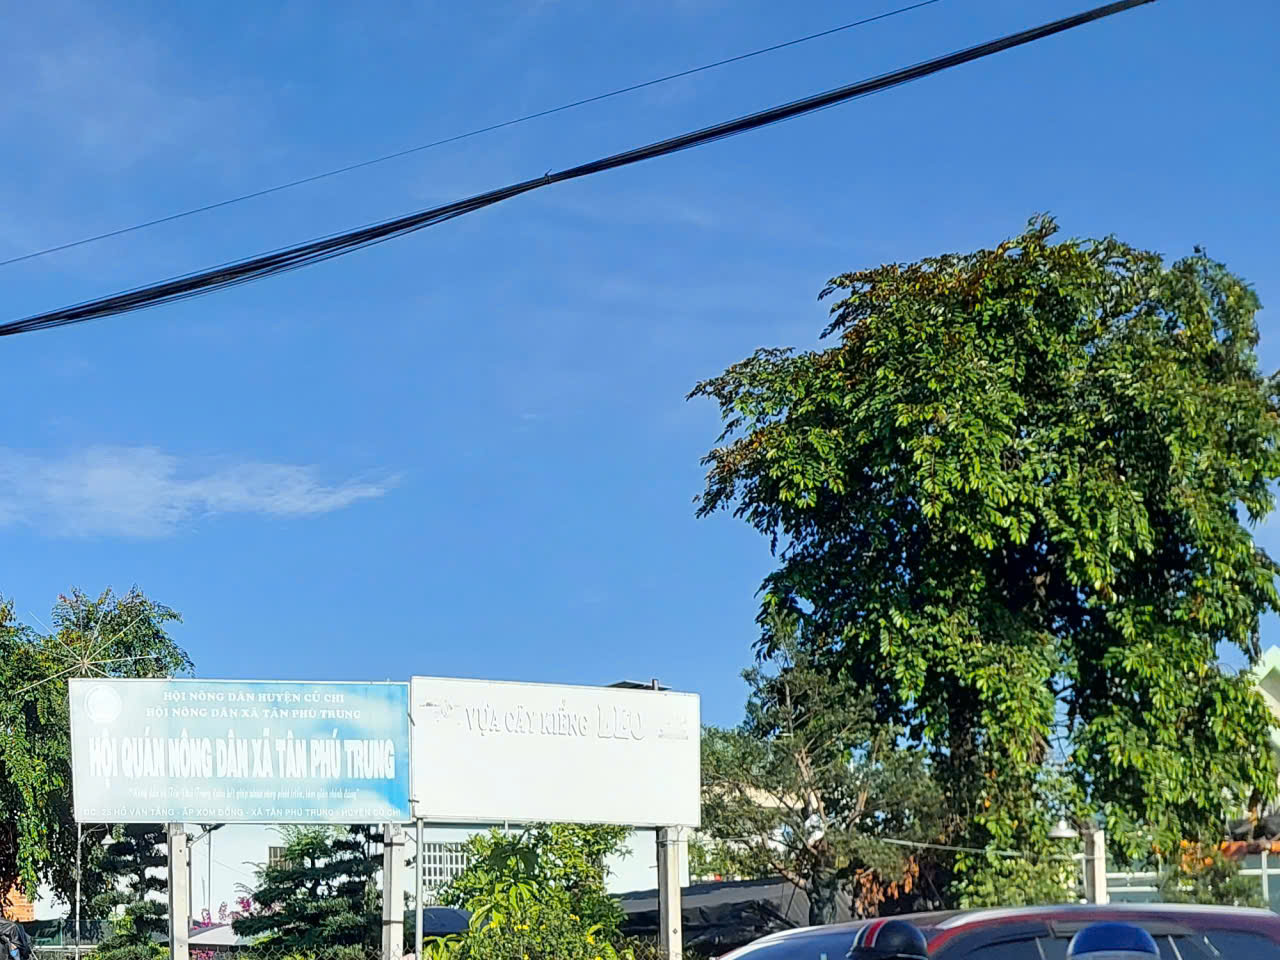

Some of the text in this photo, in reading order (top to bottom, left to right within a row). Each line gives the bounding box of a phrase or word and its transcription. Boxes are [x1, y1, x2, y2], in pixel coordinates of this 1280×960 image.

[163, 689, 186, 703] HỘI
[189, 689, 225, 703] NÔNG
[228, 690, 255, 703] DÂN
[324, 692, 345, 703] CHI
[171, 705, 208, 718] NÔNG
[211, 705, 238, 718] DÂN
[241, 706, 259, 719] XÃ
[262, 706, 289, 719] TÂN
[319, 708, 361, 719] TRUNG
[88, 727, 118, 790] HỘI
[120, 725, 165, 779] QUÁN
[168, 727, 212, 778] NÔNG
[215, 727, 249, 778] DÂN
[275, 728, 307, 779] TÂN
[309, 727, 341, 780] PHÚ
[344, 736, 396, 781] TRUNG
